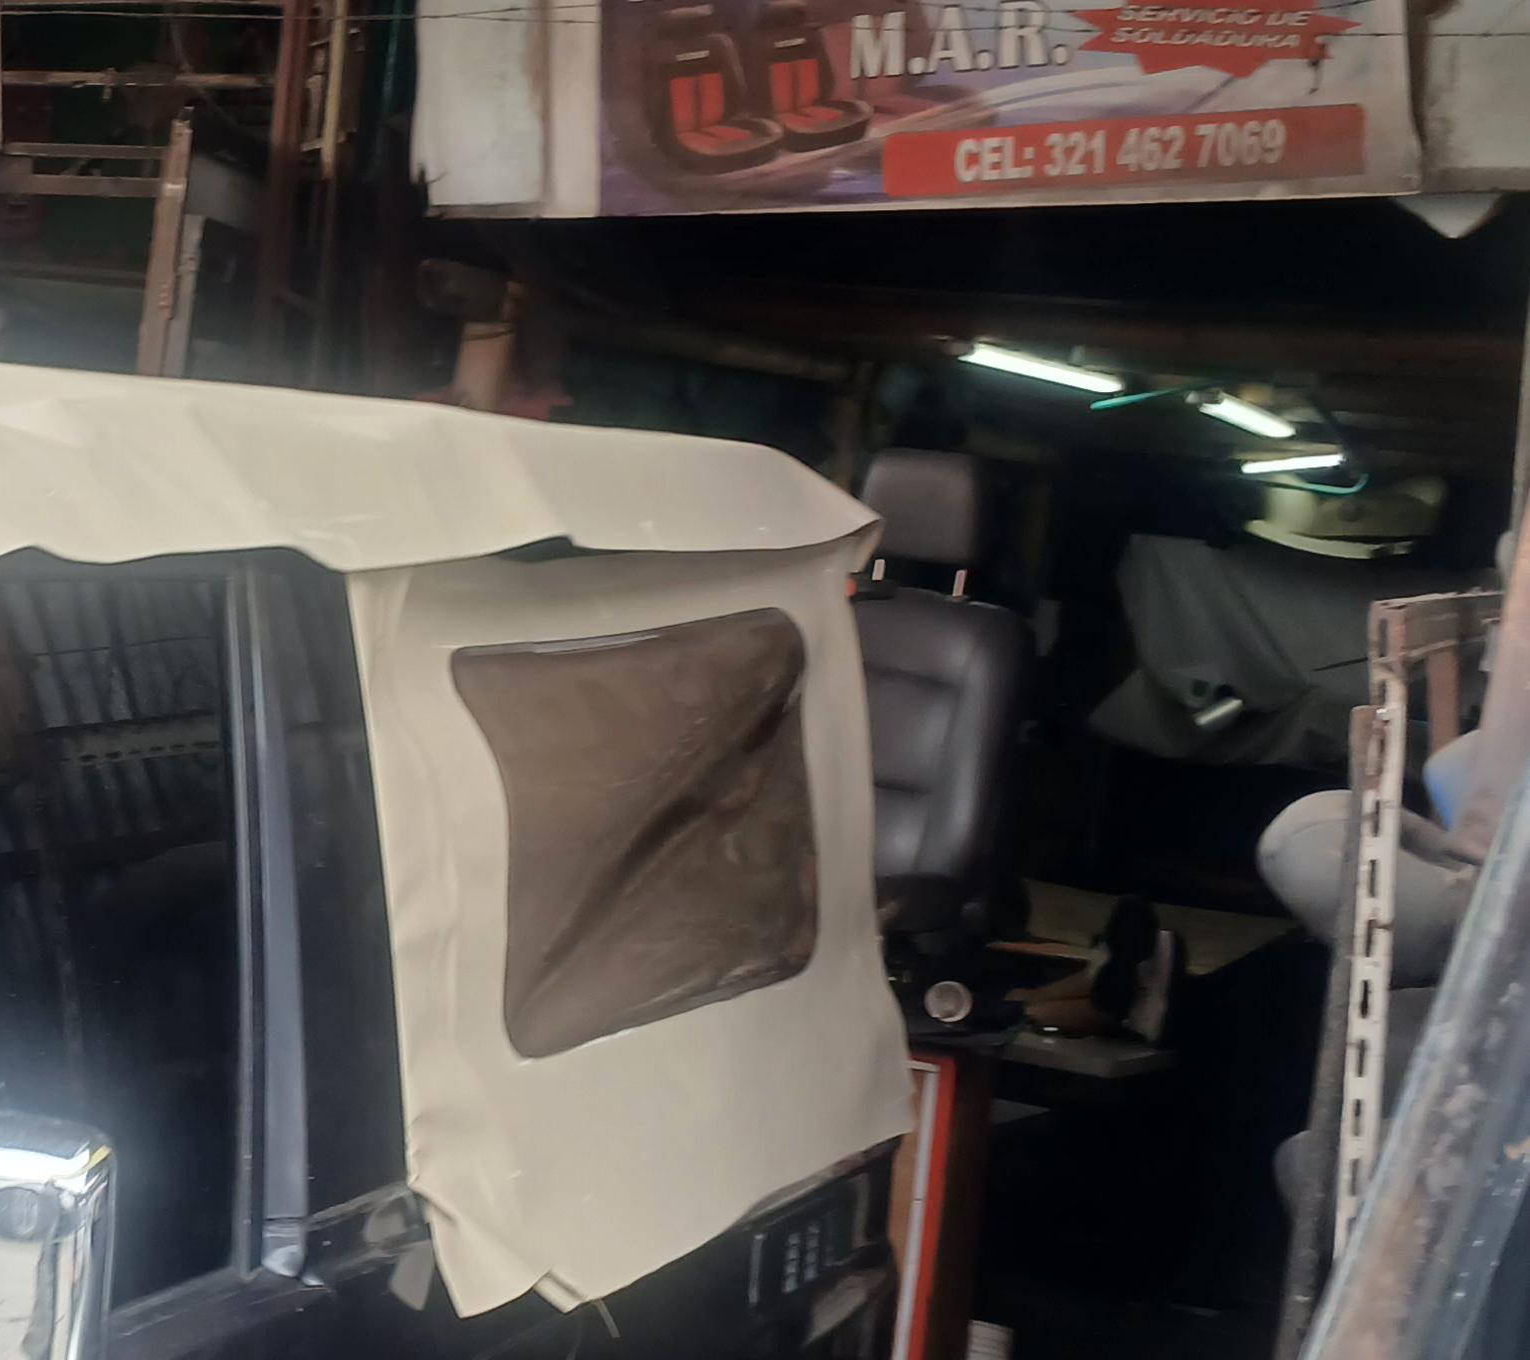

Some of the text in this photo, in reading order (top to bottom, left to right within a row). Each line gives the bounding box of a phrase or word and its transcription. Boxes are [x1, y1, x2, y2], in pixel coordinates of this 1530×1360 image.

[850, 0, 1069, 80] M.A.R.
[954, 118, 1287, 182] CEL: 321 462 7069
